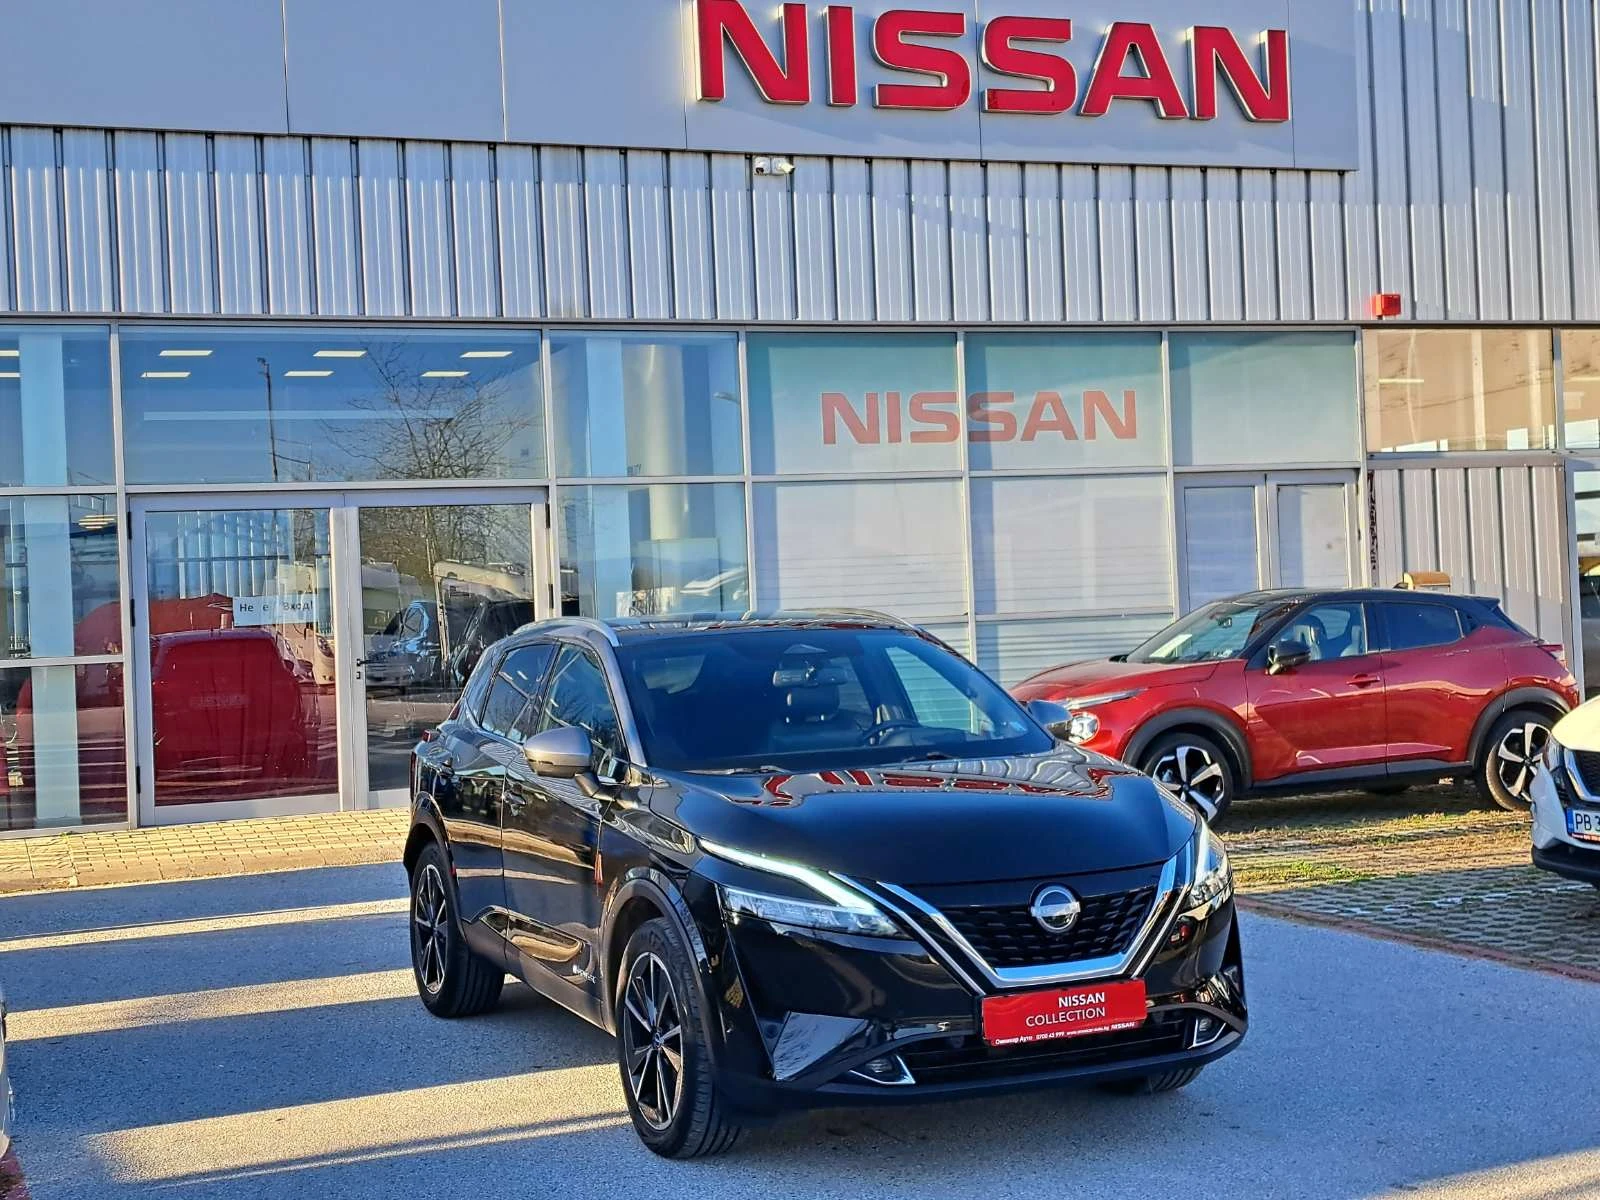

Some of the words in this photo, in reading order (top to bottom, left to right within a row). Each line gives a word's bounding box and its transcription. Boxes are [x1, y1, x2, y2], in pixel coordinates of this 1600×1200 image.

[694, 0, 1292, 122] NISSAN
[820, 390, 1137, 445] NISSAN
[239, 603, 254, 613] Не
[262, 604, 269, 612] е
[1575, 813, 1592, 831] PB
[1058, 991, 1106, 1008] NISSAN
[1025, 1006, 1106, 1028] COLLECTION
